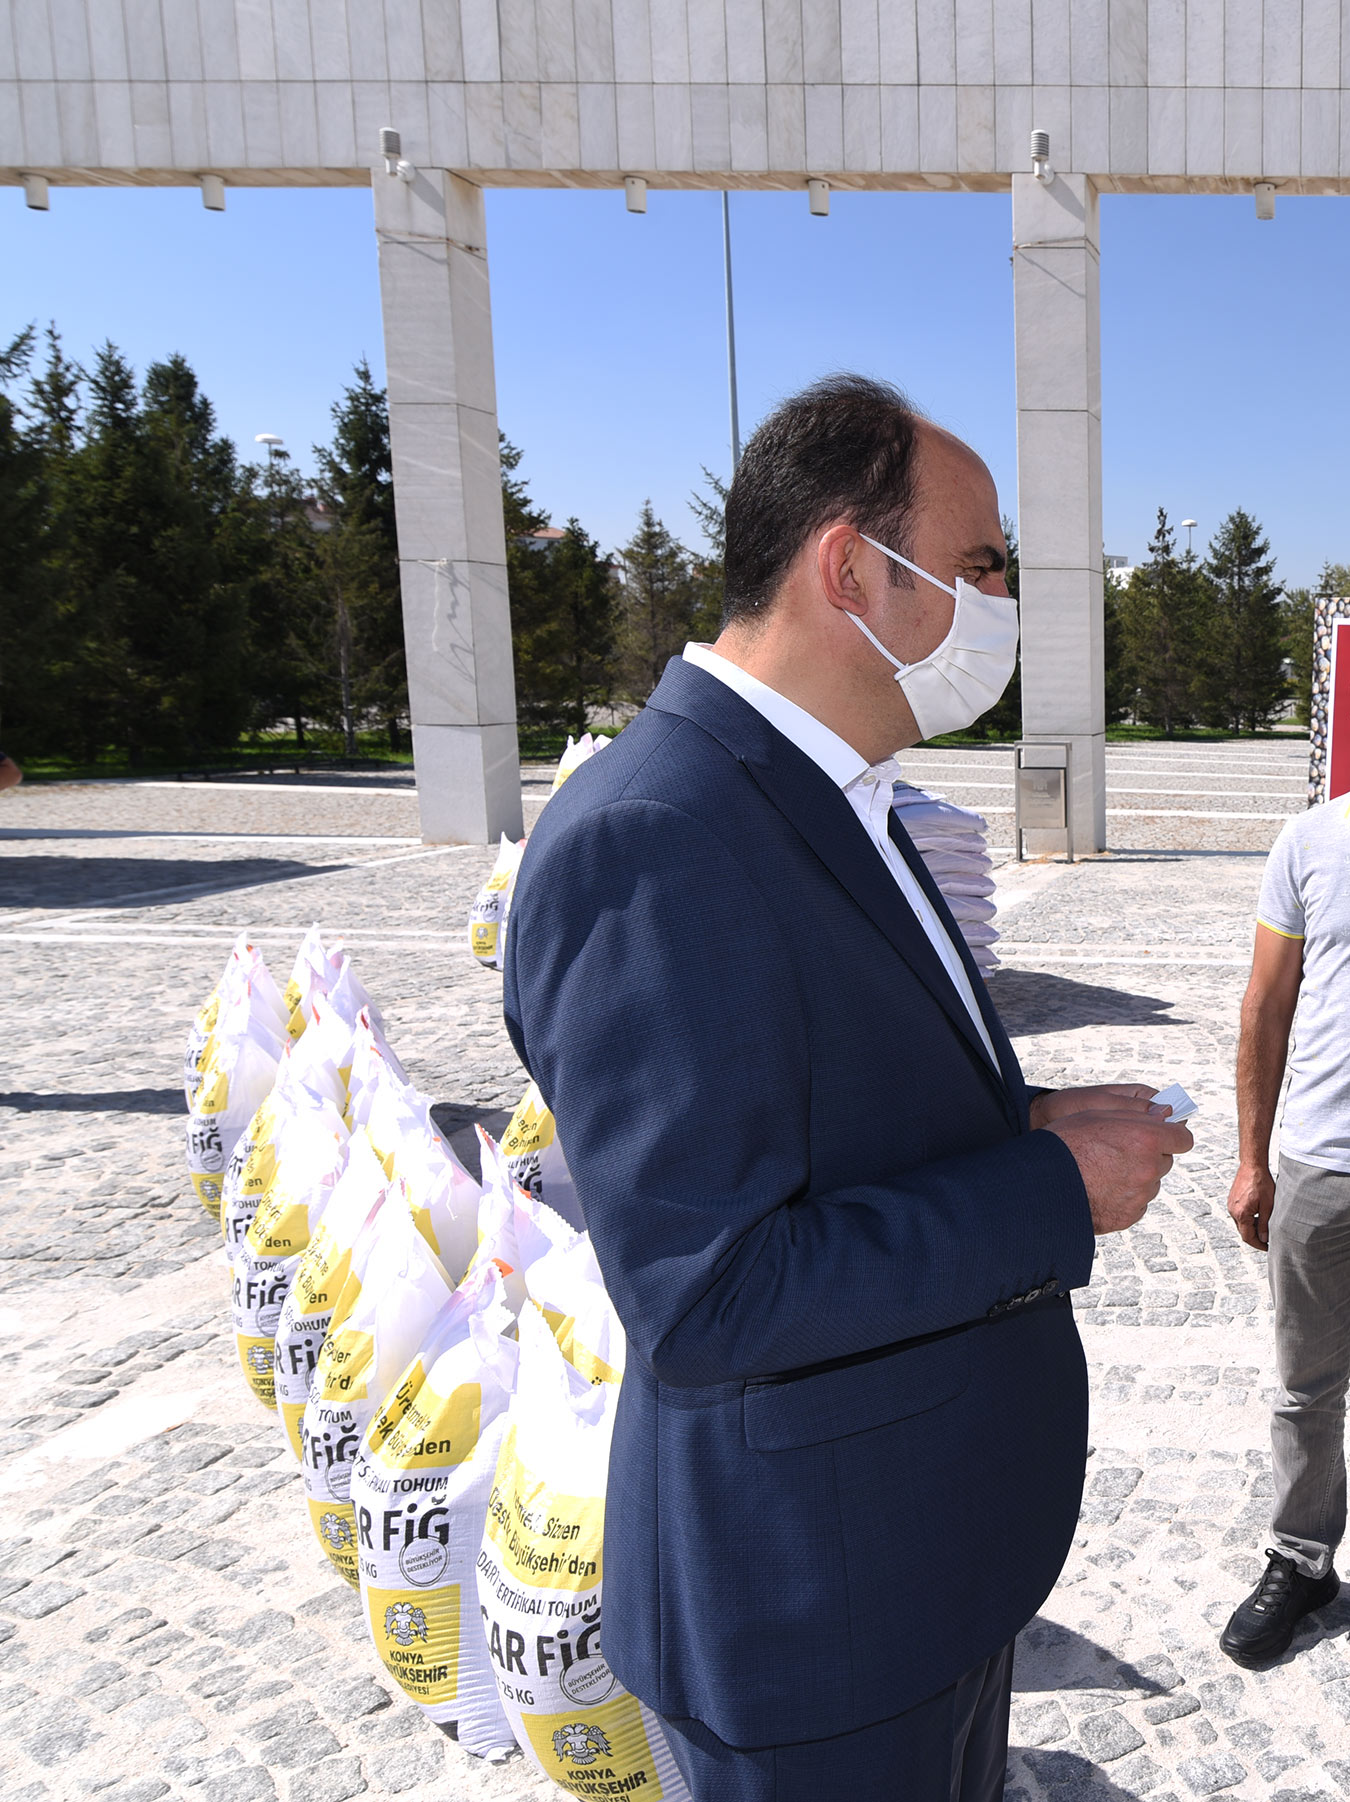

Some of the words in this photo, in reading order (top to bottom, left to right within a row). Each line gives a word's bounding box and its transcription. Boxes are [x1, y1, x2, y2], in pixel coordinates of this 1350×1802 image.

[393, 1476, 449, 1493] TOHUM
[548, 1594, 598, 1618] TOHUM
[390, 1650, 425, 1665] KONYA
[567, 1663, 607, 1688] BÜYÜKŞEHİR
[515, 1688, 535, 1706] KG
[566, 1768, 617, 1781] KONYA
